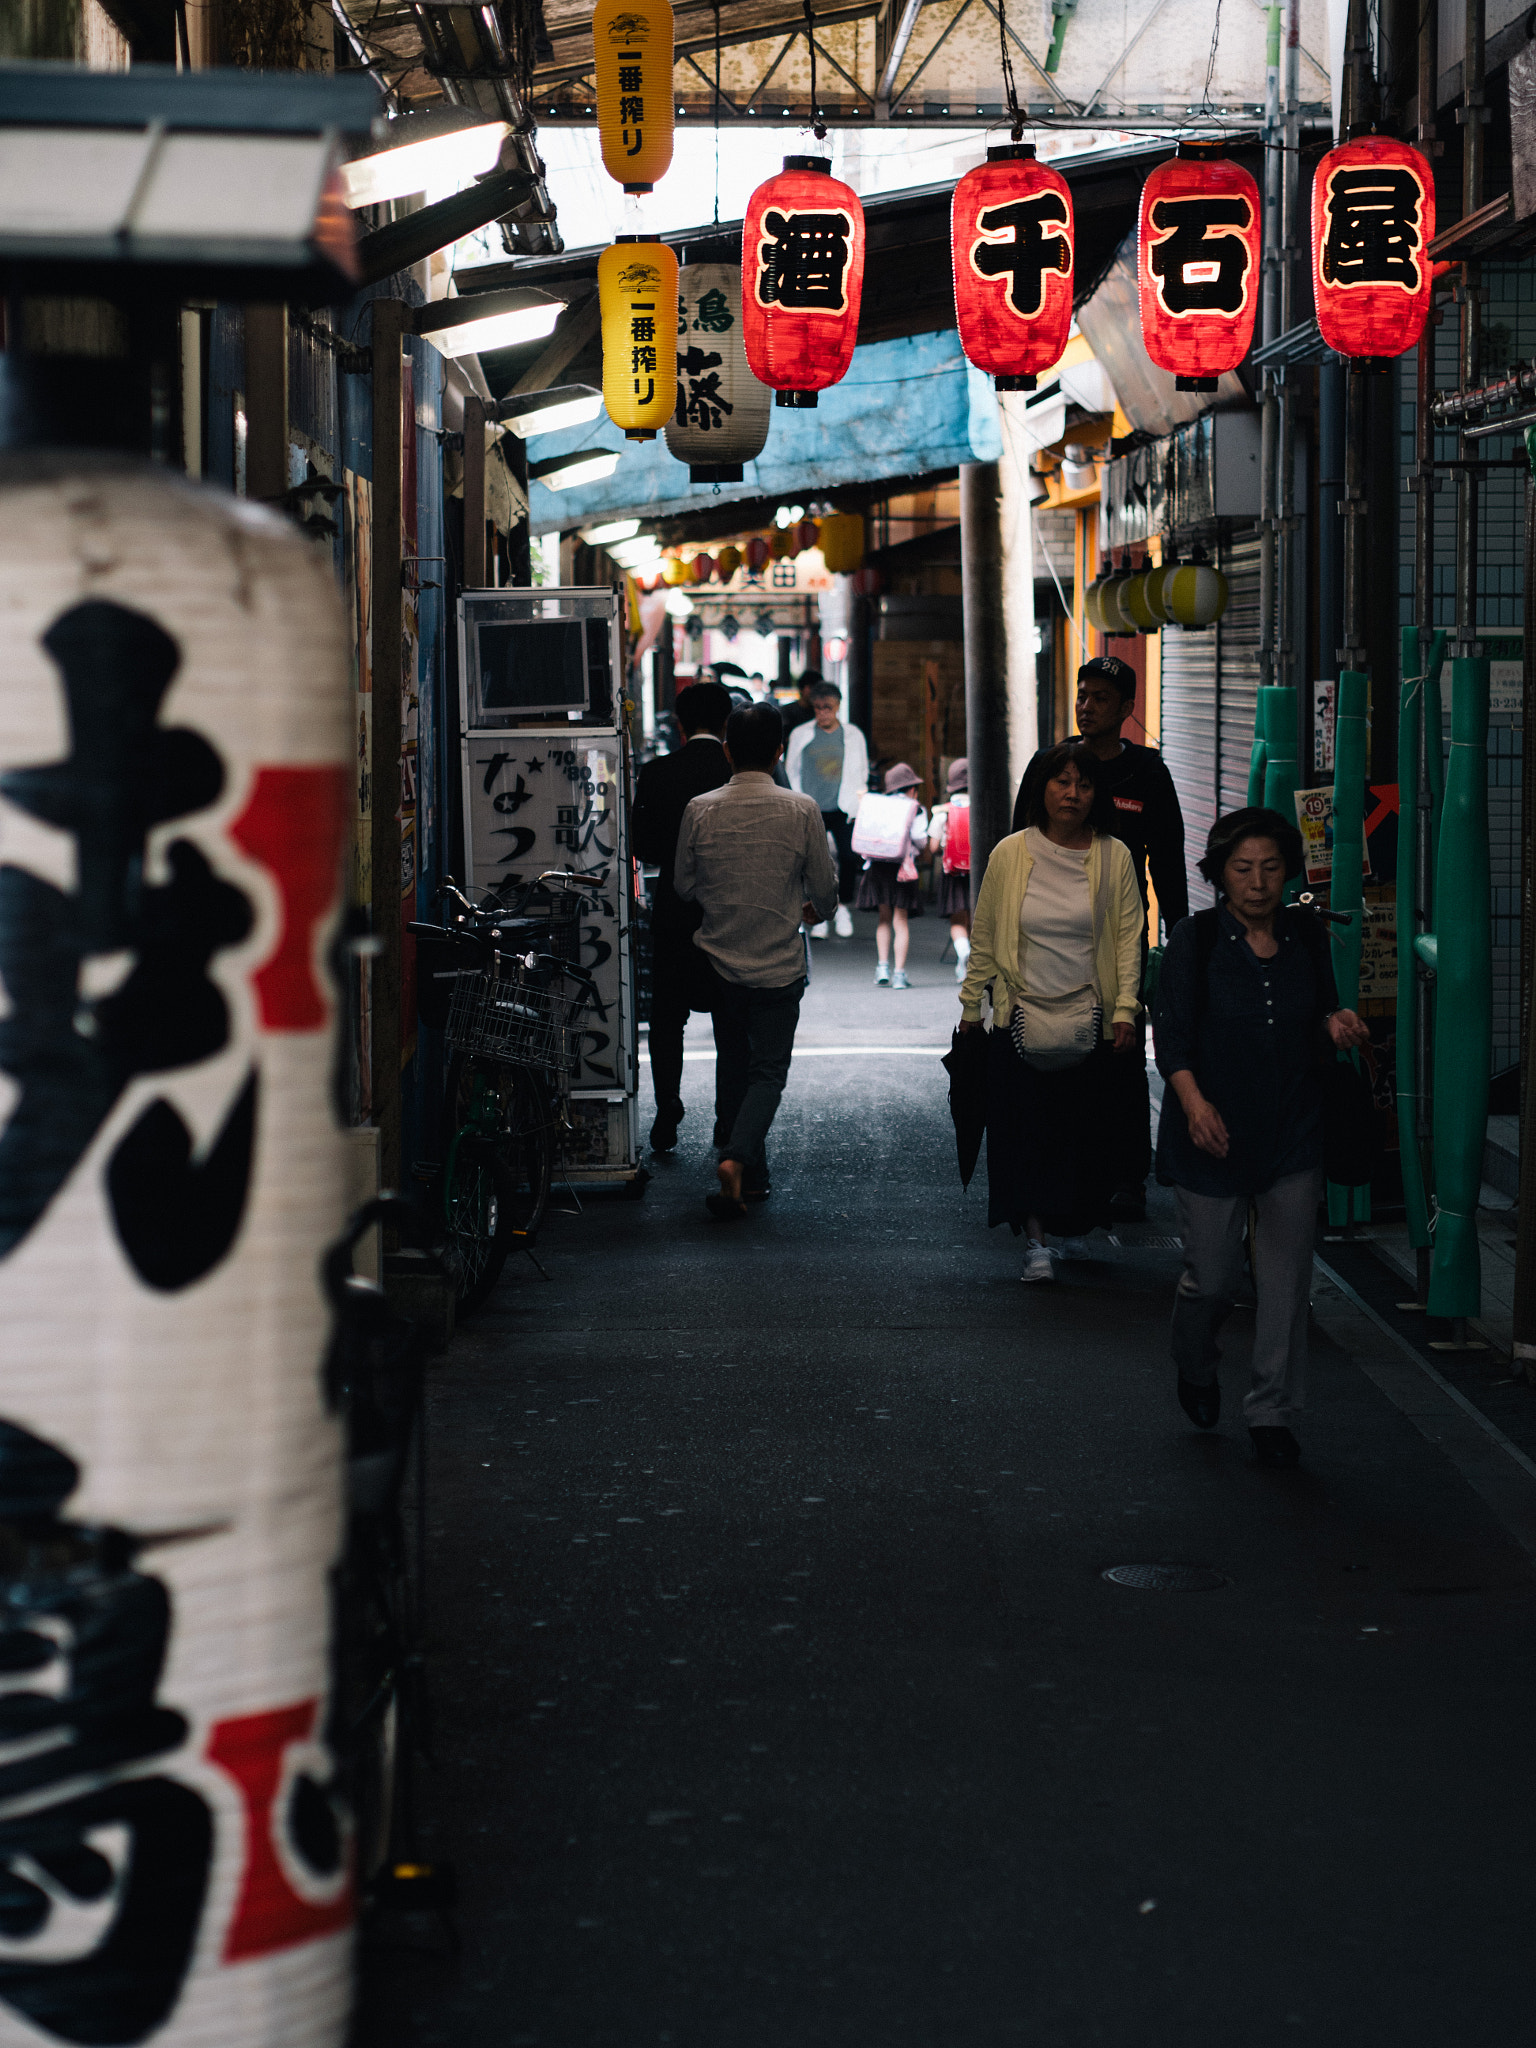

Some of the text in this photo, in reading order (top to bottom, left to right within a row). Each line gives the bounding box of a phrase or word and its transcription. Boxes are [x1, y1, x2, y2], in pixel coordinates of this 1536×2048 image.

[615, 51, 643, 156] 一番搾り
[971, 191, 1071, 318] 千
[1149, 196, 1252, 315] 石
[1321, 167, 1422, 293] 屋
[629, 302, 657, 406] 一番搾り
[1101, 661, 1120, 676] 29
[548, 750, 576, 766] '70
[563, 766, 592, 781] '80
[579, 782, 608, 796] '90
[1308, 799, 1322, 813] 19
